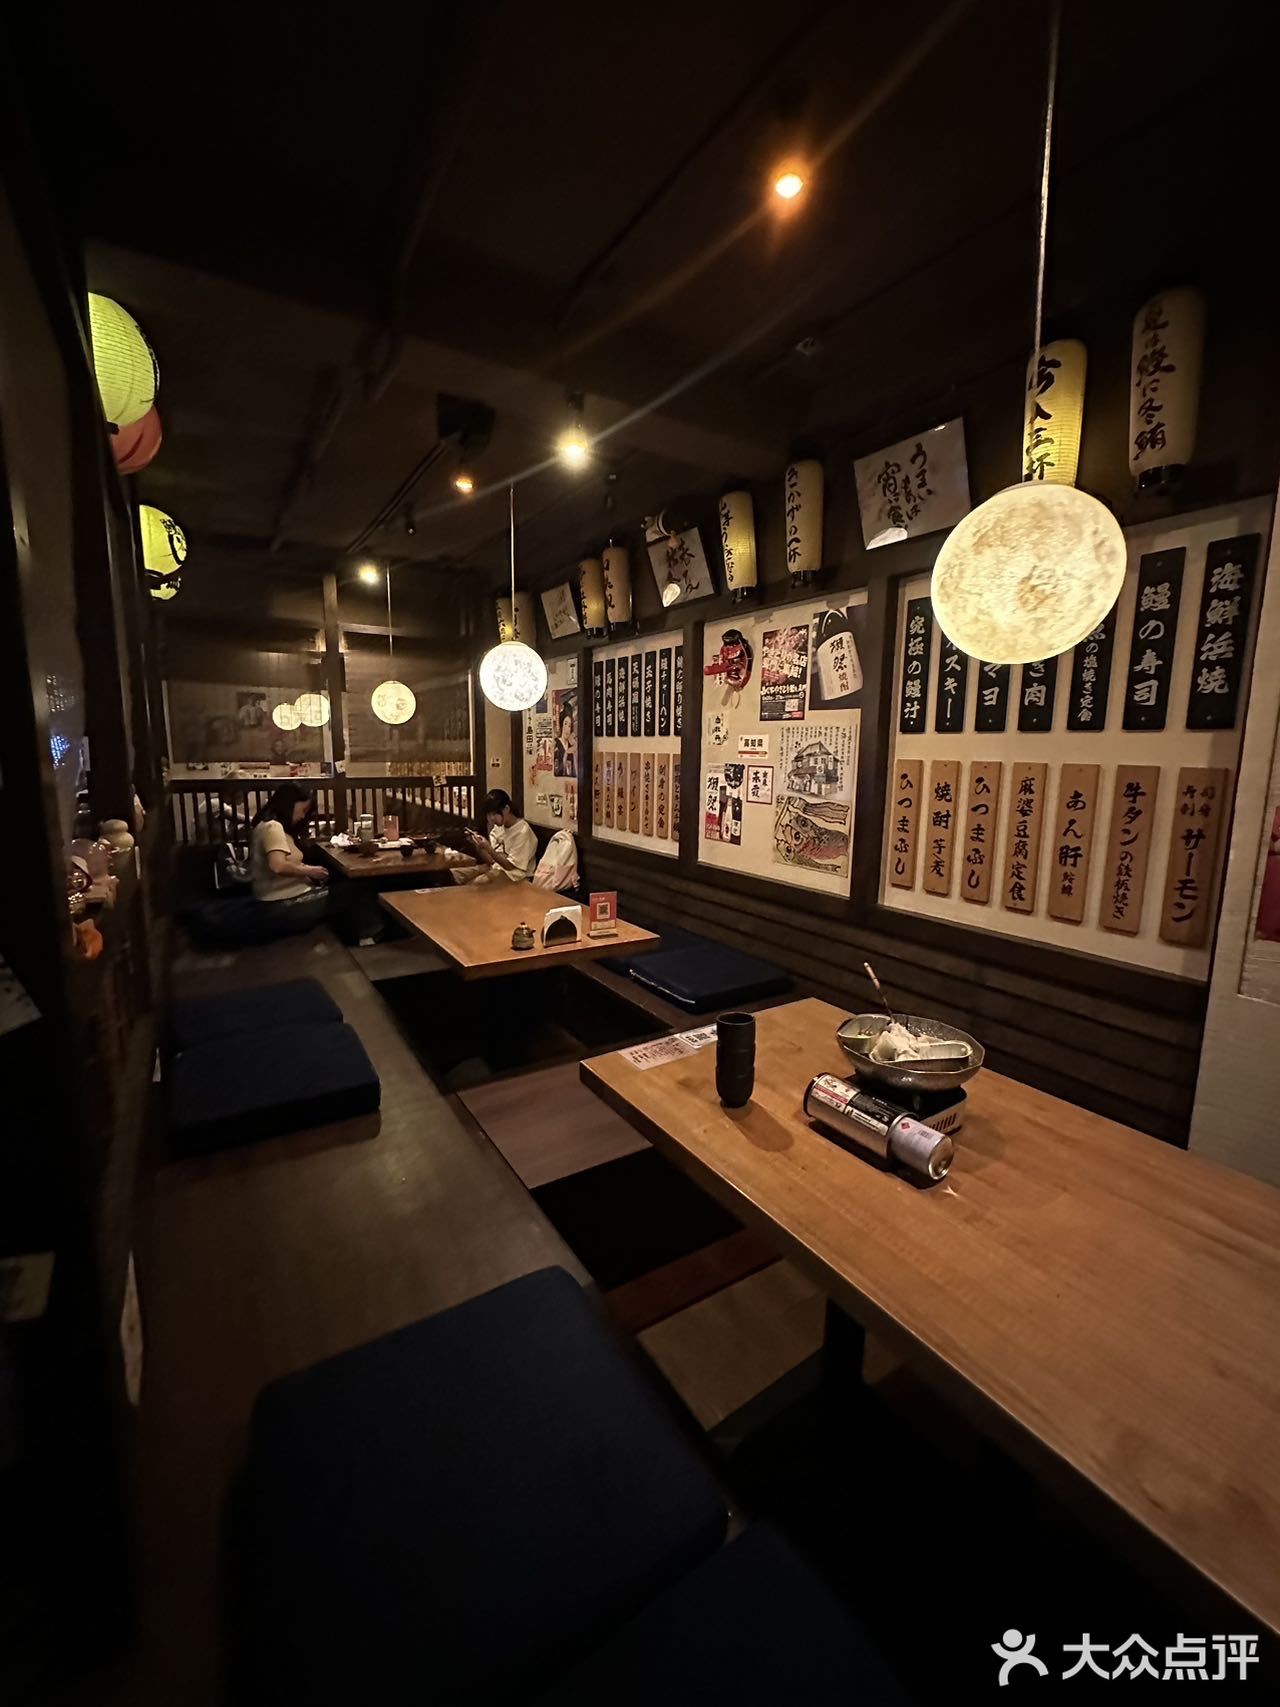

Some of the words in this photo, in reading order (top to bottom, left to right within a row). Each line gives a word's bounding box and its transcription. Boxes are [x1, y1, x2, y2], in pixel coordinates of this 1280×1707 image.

[904, 615, 926, 719] 究極の鰻汁
[1132, 582, 1171, 706] 鰻の寿司
[1196, 562, 1245, 695] 海鮮浜焼
[894, 773, 914, 875] ひつまぶし
[932, 782, 953, 829] 焼酎
[966, 776, 991, 889] ひつまぶし
[1008, 776, 1037, 902] 麻婆豆腐定食
[1058, 791, 1088, 868] あん肝
[1112, 782, 1147, 919] 牛タンの鉄板焼き
[1171, 827, 1208, 923] サーモン
